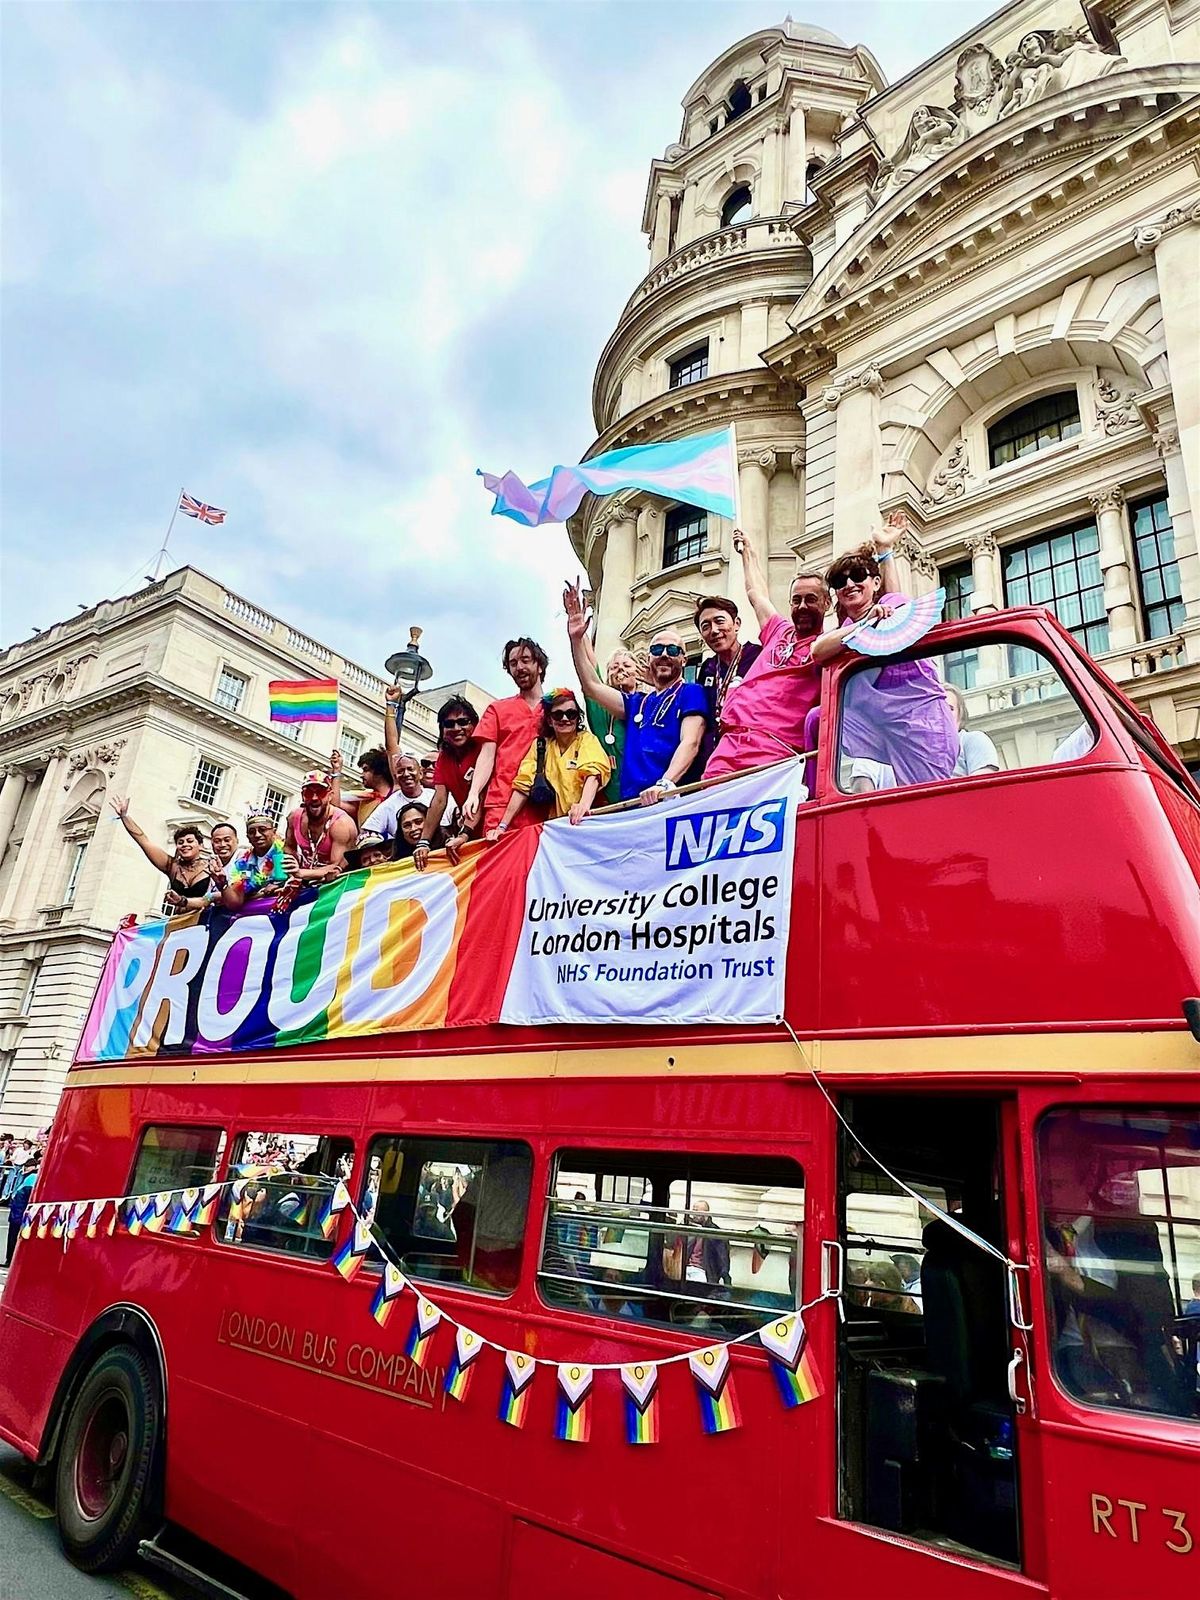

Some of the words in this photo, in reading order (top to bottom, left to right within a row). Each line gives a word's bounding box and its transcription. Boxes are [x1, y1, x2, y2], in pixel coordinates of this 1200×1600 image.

[669, 802, 783, 866] NHS
[528, 890, 656, 922] University
[663, 874, 778, 910] College
[91, 872, 458, 1052] PROUD
[531, 924, 620, 956] London
[632, 910, 776, 955] Hospitals
[557, 964, 590, 984] NHS
[595, 959, 713, 982] Foundation
[722, 956, 775, 979] Trust
[218, 1309, 297, 1355] LONDON
[302, 1331, 337, 1368] BUS
[1091, 1493, 1147, 1543] RT
[1162, 1508, 1193, 1553] 3
